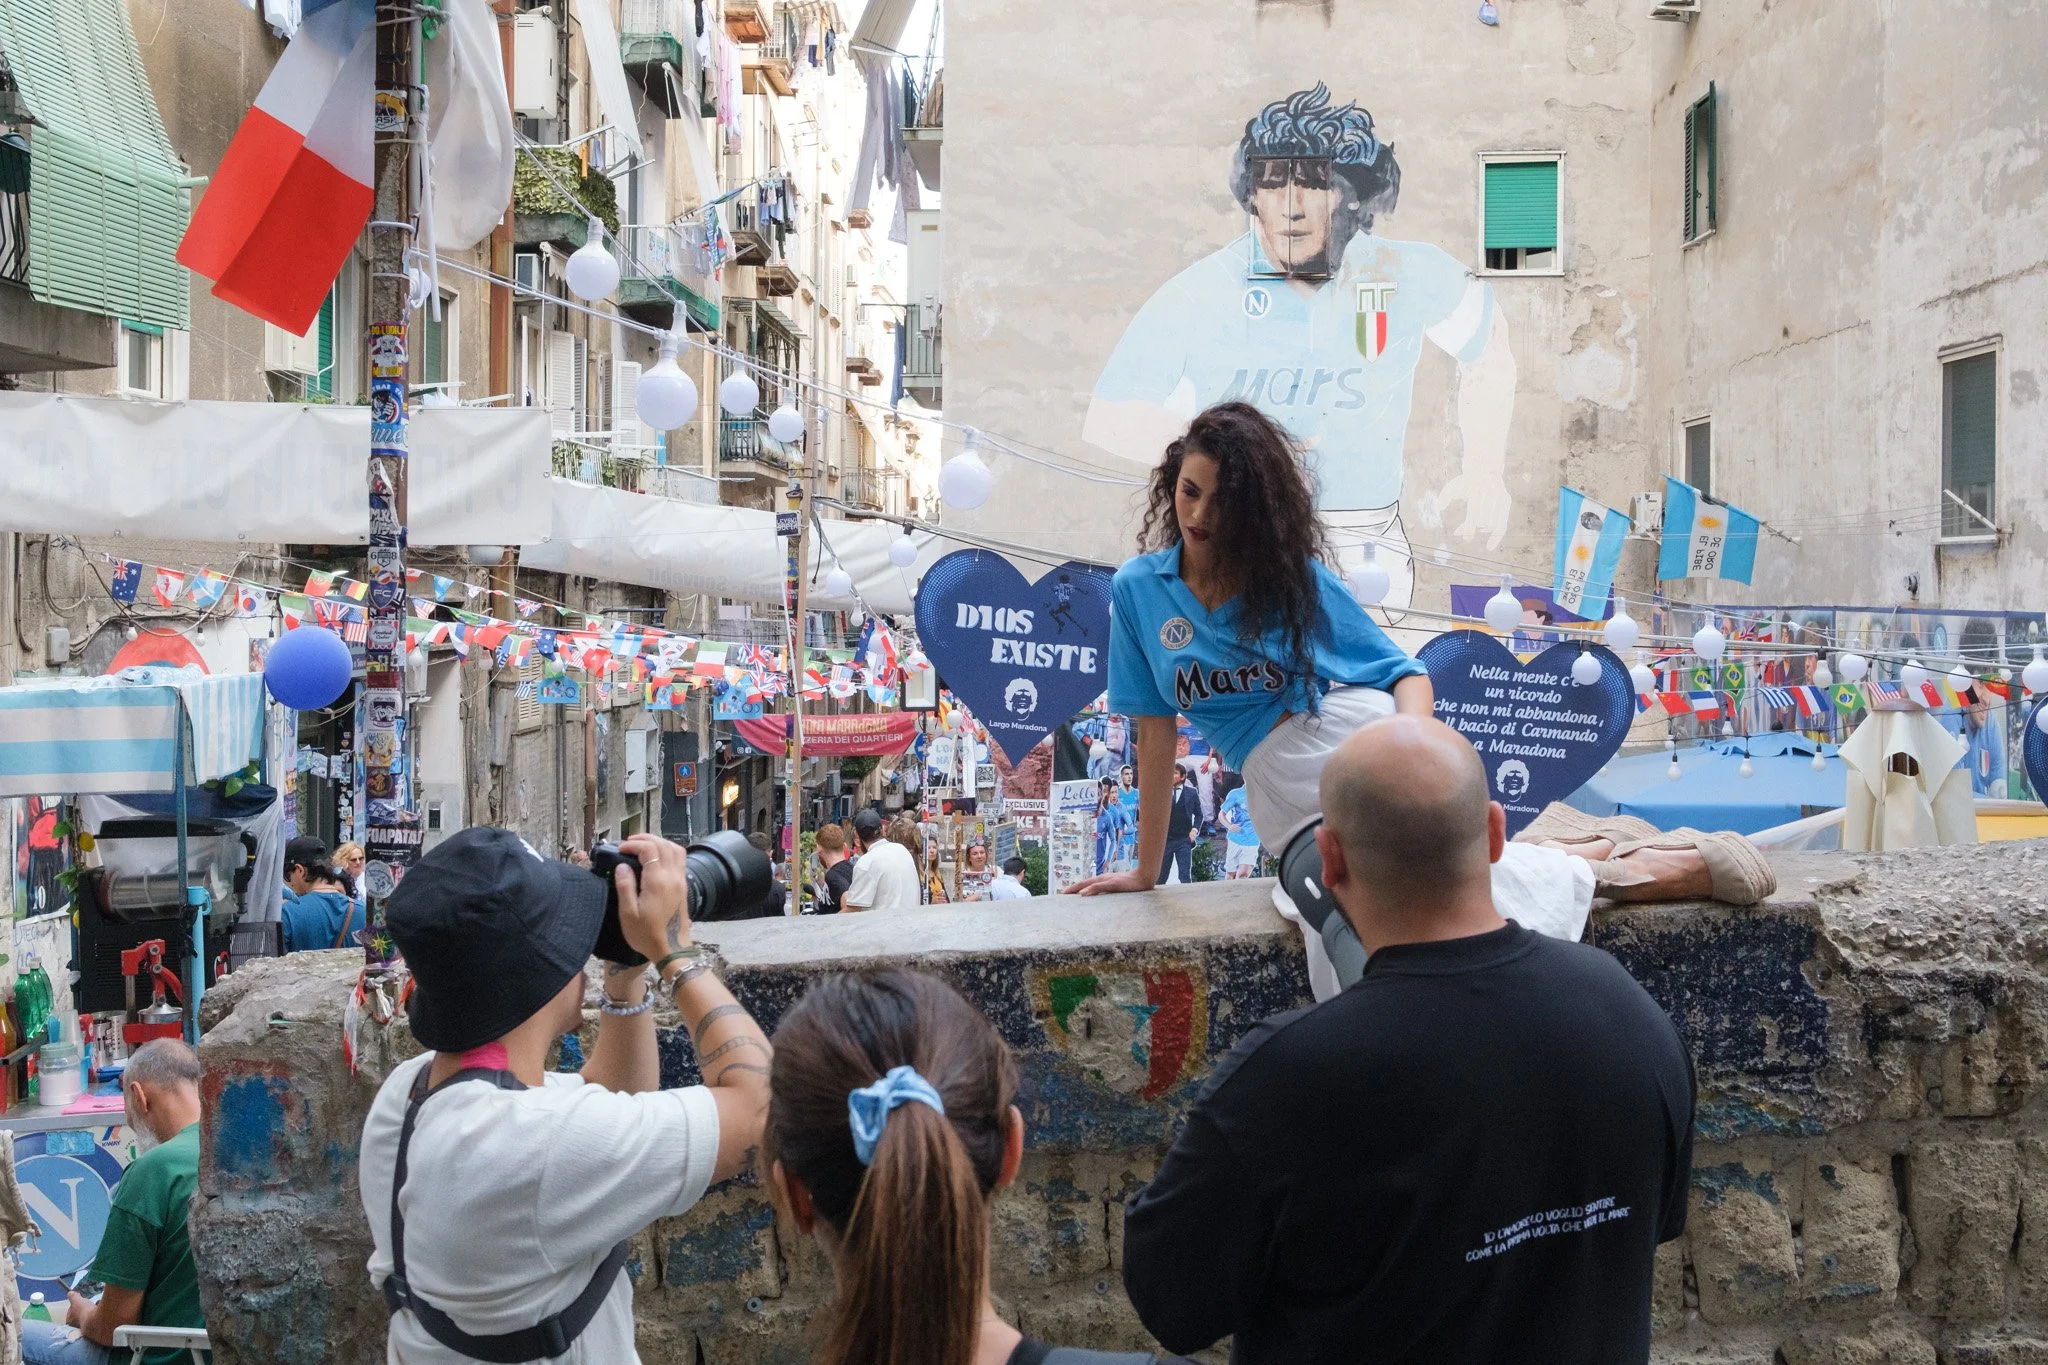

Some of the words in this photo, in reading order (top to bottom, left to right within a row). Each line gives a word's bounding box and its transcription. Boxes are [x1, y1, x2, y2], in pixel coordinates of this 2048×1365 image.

[1247, 292, 1266, 315] N
[373, 589, 392, 598] FC
[1170, 627, 1183, 641] N
[990, 638, 1097, 673] EXISTE
[1470, 664, 1509, 681] Nella
[1513, 672, 1557, 685] mente
[1175, 660, 1285, 709] Mars
[1485, 687, 1504, 698] un
[1508, 687, 1562, 704] ricordo
[1434, 699, 1457, 712] che
[1461, 703, 1488, 715] non
[1492, 704, 1512, 717] mi
[989, 720, 1010, 729] Largo
[1012, 722, 1047, 731] Maradona
[1458, 718, 1497, 733] bacio
[1501, 723, 1516, 735] di
[1522, 723, 1598, 743] Carmando
[853, 733, 903, 743] QUARTIERI
[1489, 739, 1566, 759] Maradona
[1006, 801, 1045, 809] EXCLUSIVE
[1503, 804, 1539, 813] Maradona
[1546, 1207, 1583, 1223] VOGLIO
[1465, 1246, 1493, 1263] COME
[1495, 1242, 1506, 1255] LA
[1532, 1223, 1560, 1239] VOLTA
[1562, 1220, 1582, 1233] CHE
[1608, 1206, 1631, 1221] MARE
